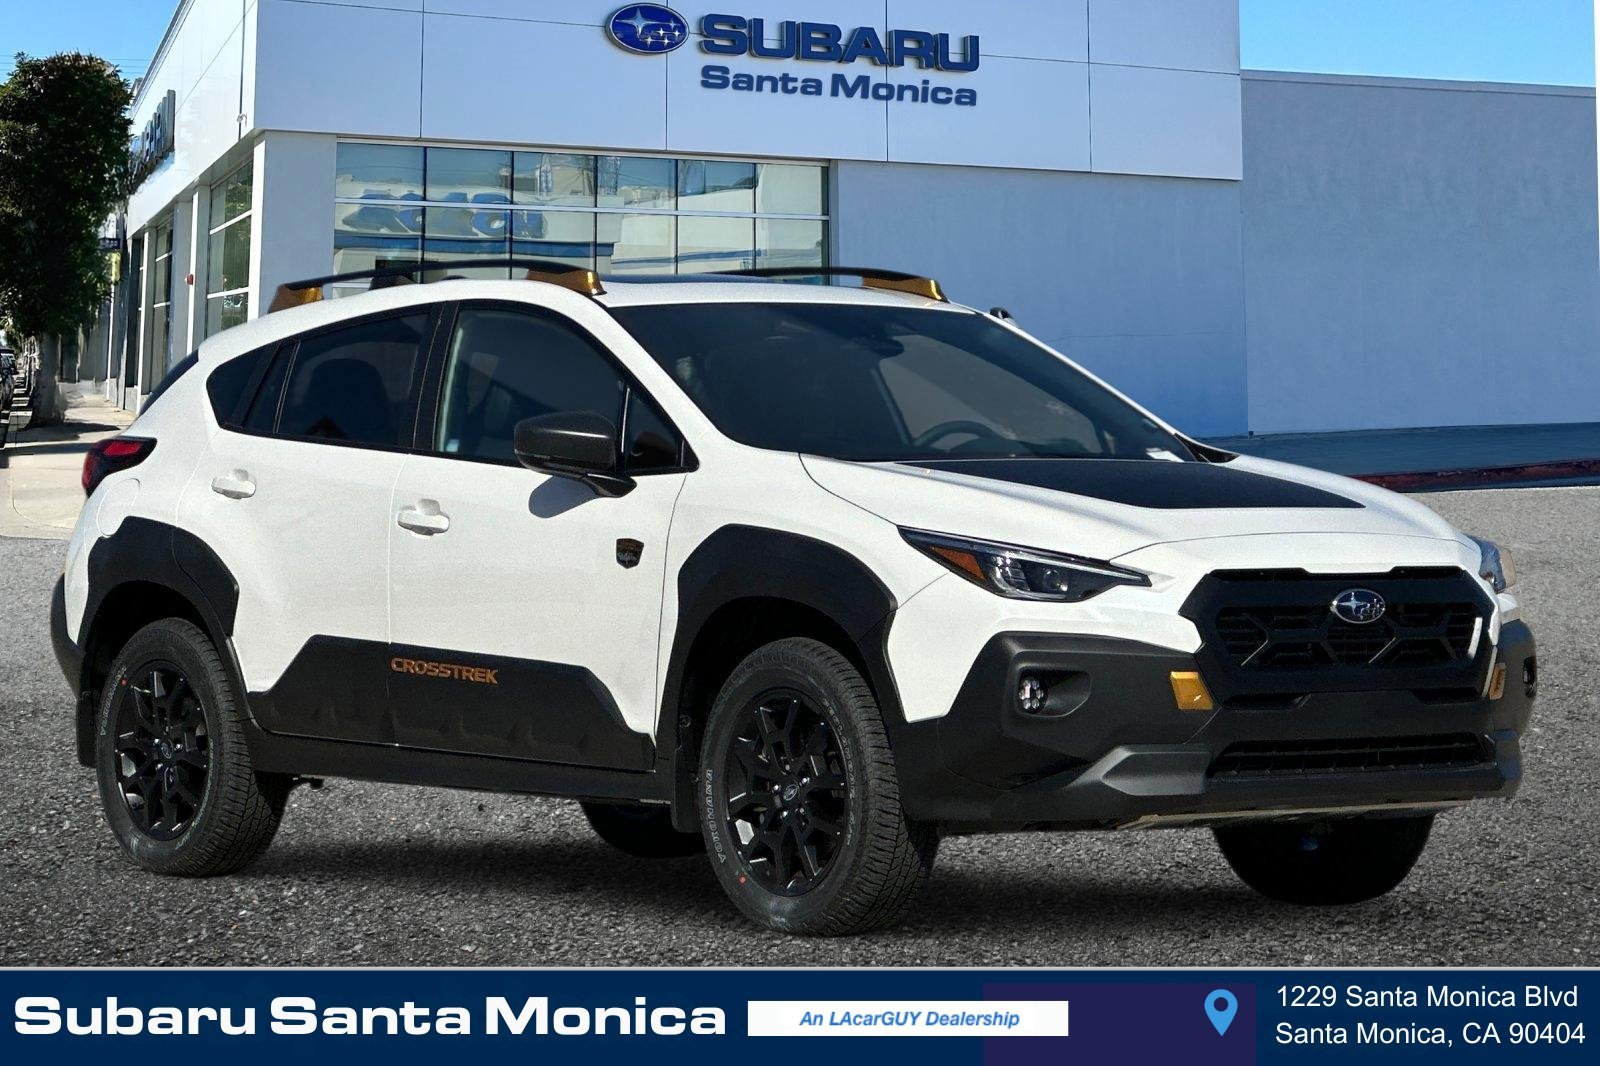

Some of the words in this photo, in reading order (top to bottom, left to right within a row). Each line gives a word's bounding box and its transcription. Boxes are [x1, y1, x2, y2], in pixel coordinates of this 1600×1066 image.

[700, 13, 980, 72] SUBARU
[700, 64, 823, 97] Santa
[830, 73, 977, 106] Monica
[390, 657, 499, 684] CROSSTREK
